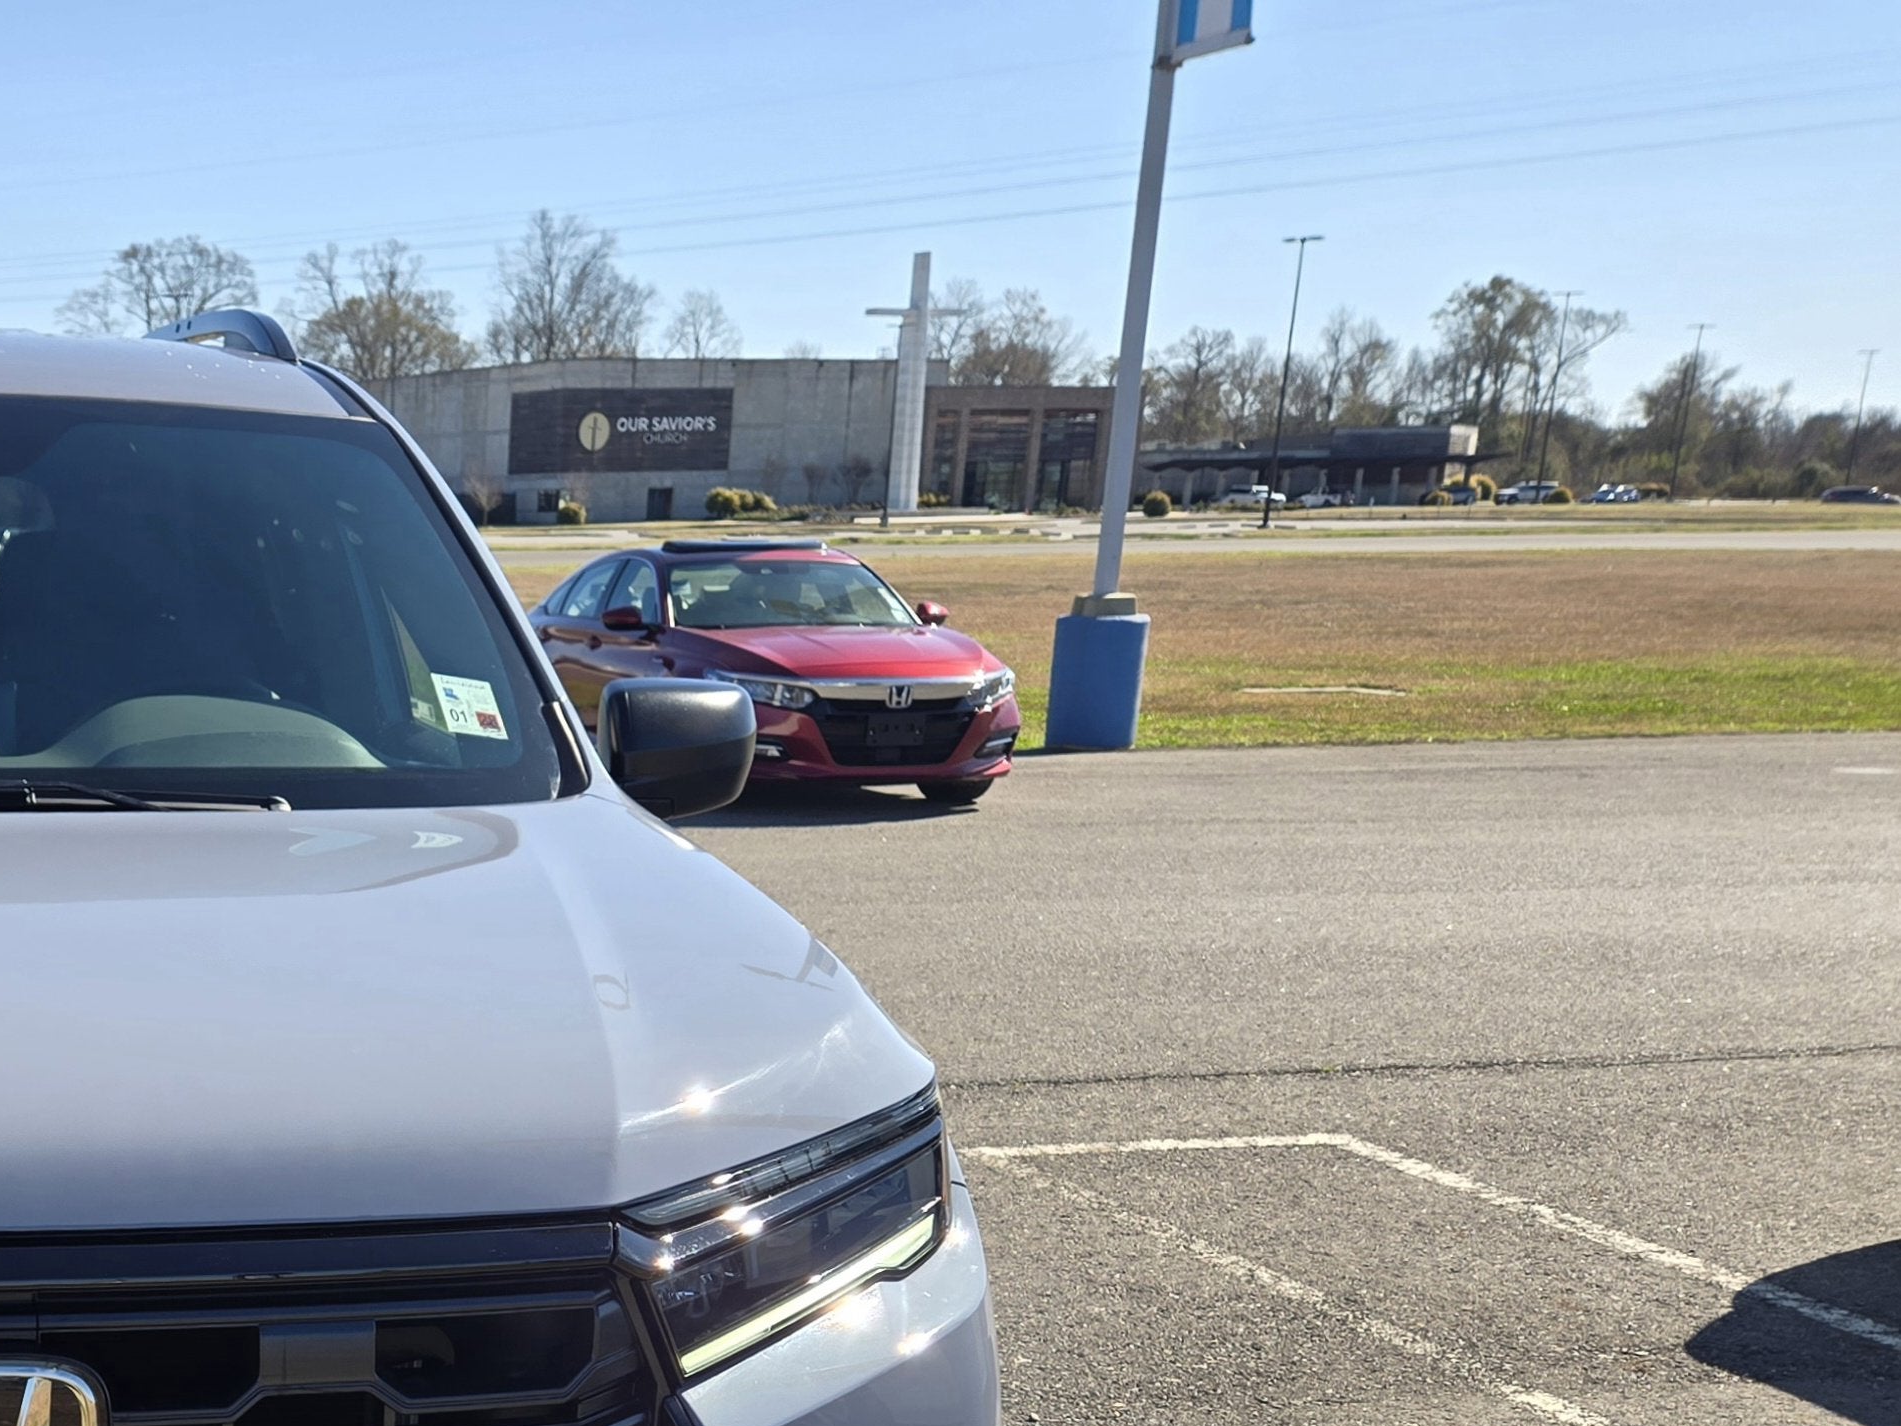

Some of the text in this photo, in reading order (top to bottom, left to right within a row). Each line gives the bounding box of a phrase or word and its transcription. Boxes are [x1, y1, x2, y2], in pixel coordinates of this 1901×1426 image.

[616, 416, 716, 432] OUR SAVIOR'S
[643, 433, 689, 444] CHURCH
[450, 708, 468, 723] 01
